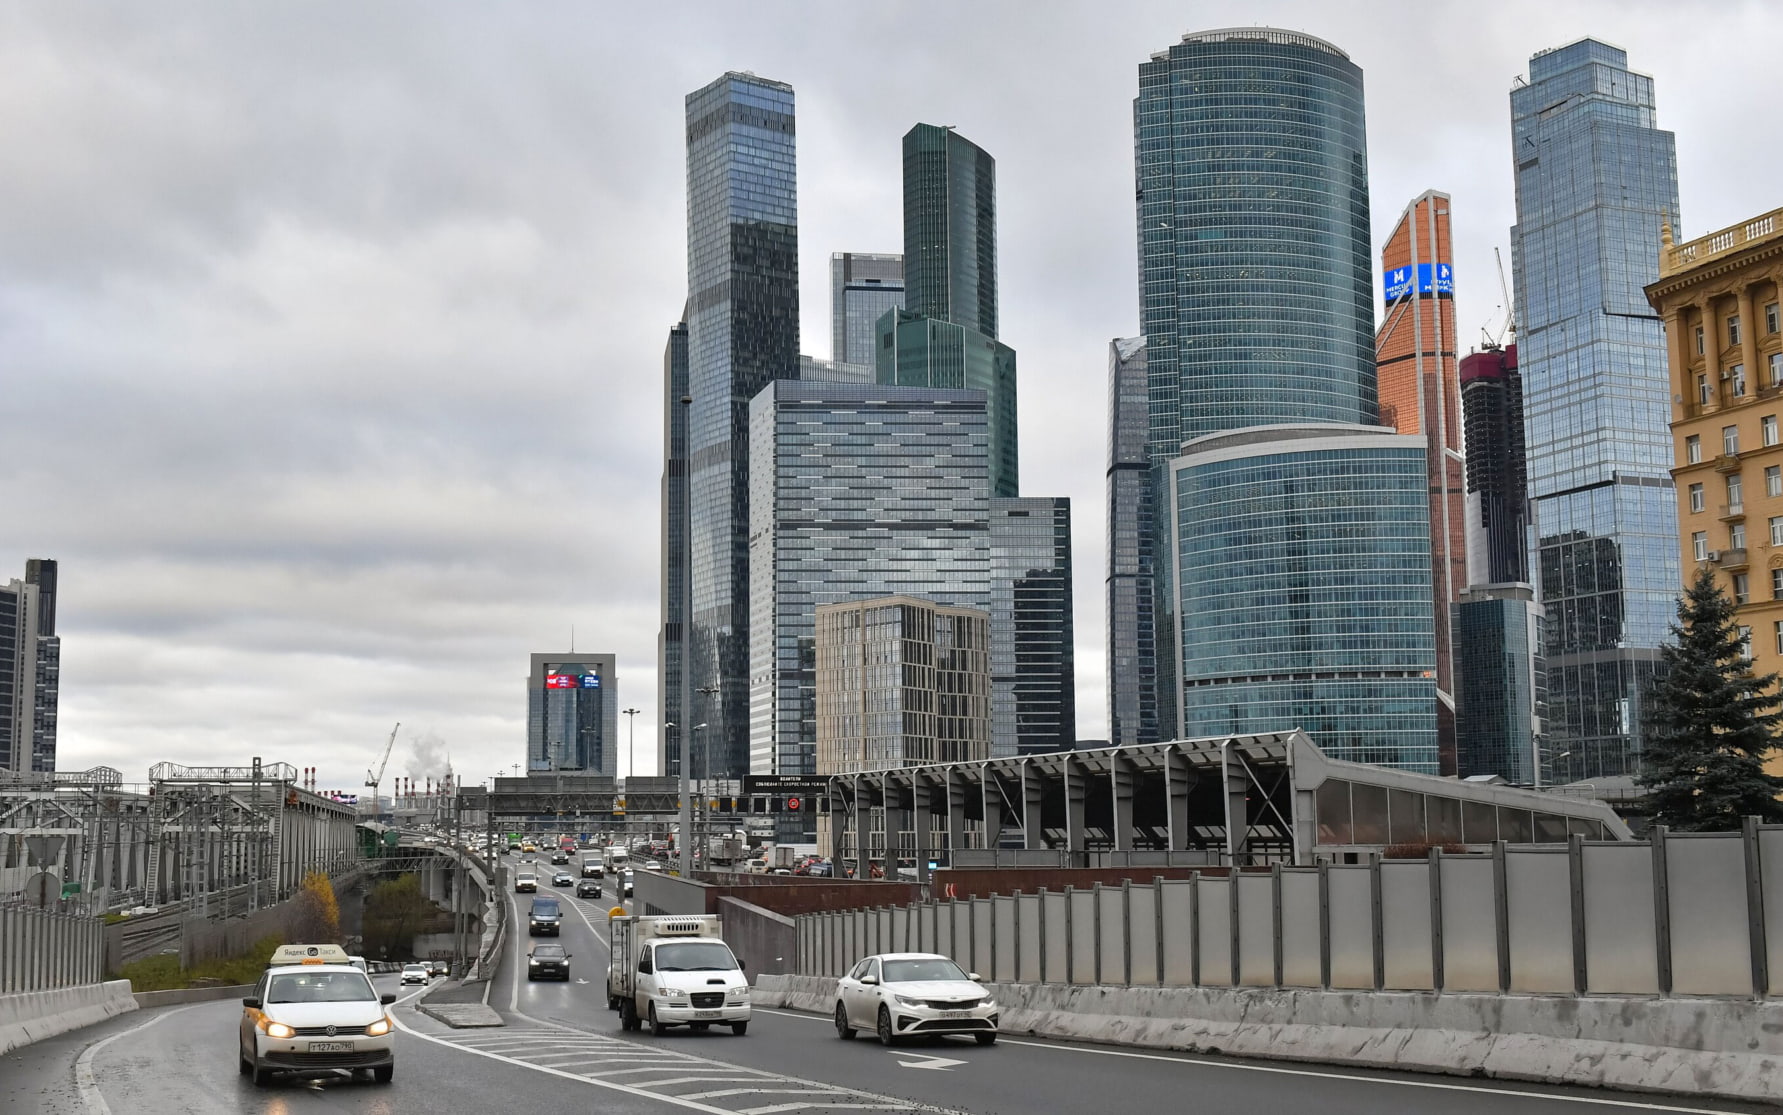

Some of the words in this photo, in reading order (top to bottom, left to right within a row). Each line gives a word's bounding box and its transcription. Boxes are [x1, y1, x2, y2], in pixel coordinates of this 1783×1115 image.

[285, 948, 306, 956] Яндекс
[308, 948, 318, 956] Go
[319, 947, 336, 956] Такси
